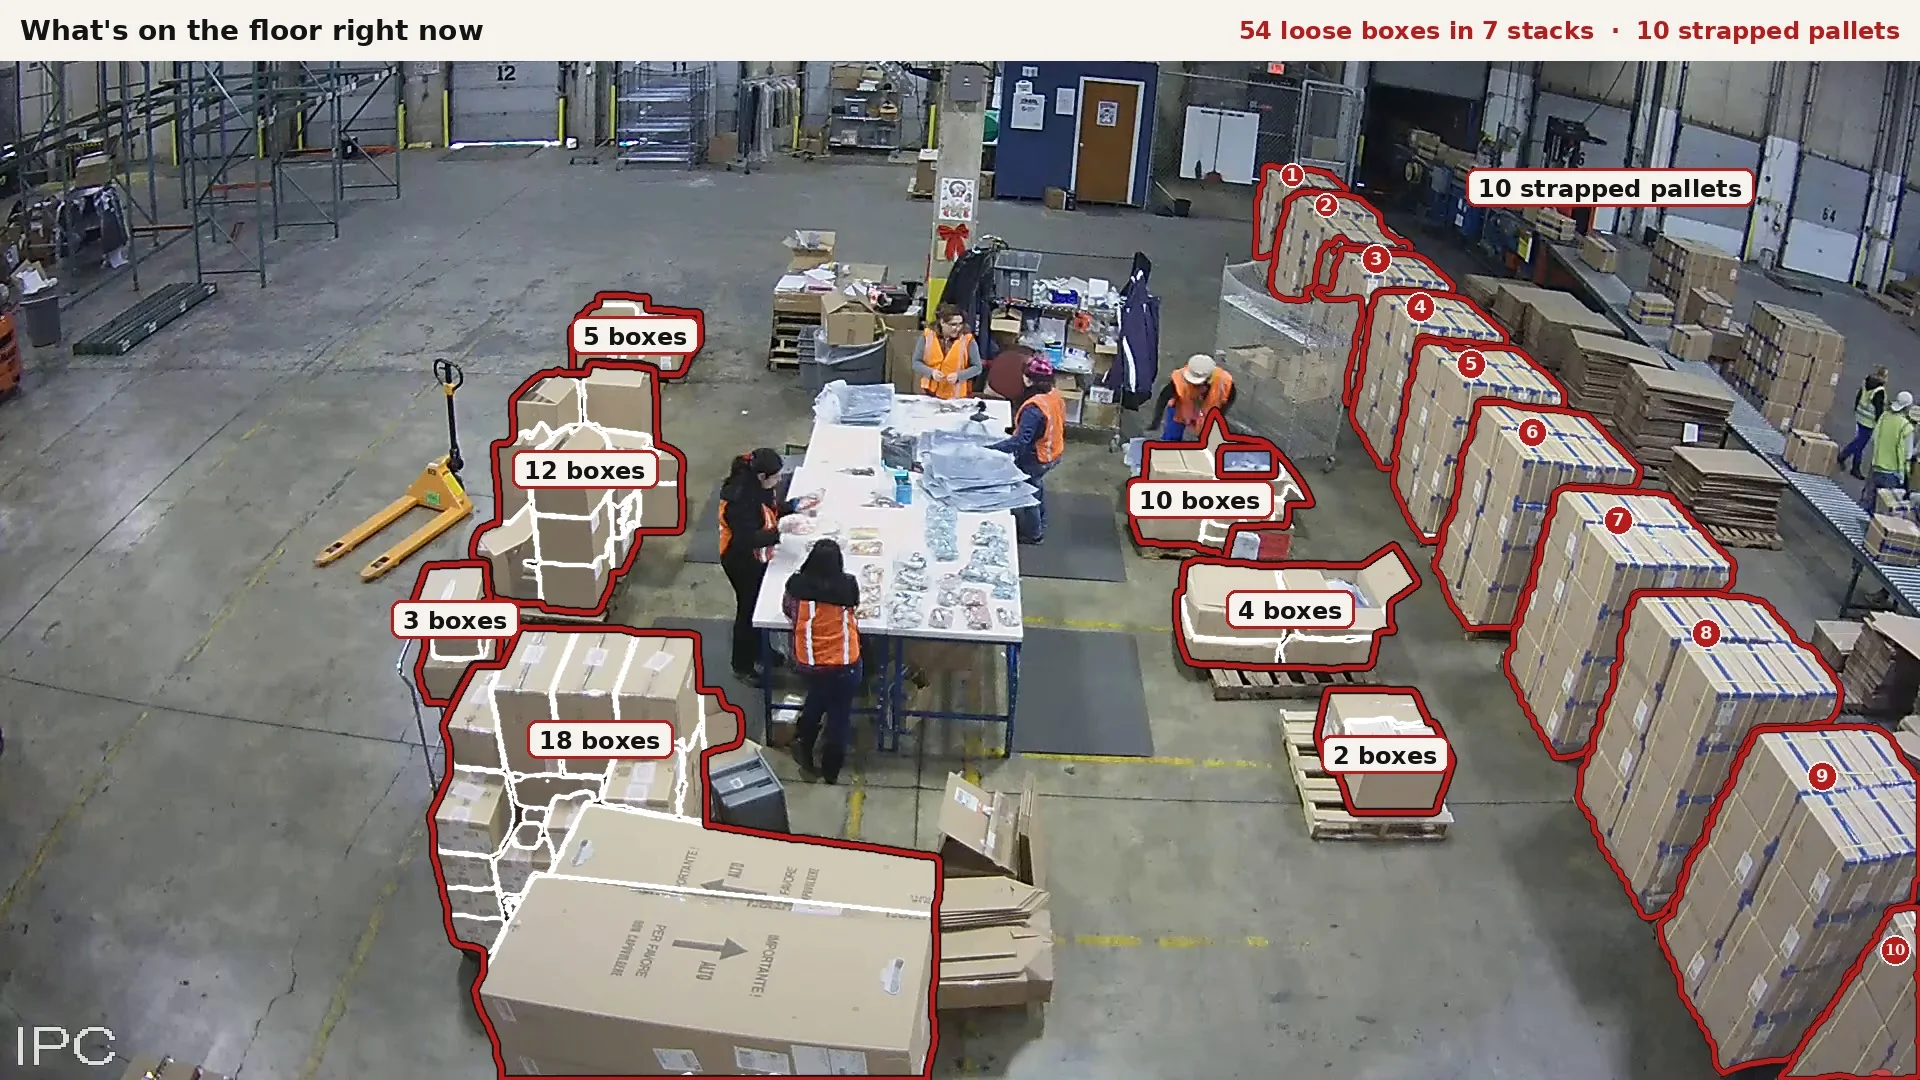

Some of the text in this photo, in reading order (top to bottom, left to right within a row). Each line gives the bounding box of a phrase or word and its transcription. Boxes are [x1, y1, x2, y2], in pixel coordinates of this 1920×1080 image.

[497, 65, 516, 81] 12
[650, 924, 667, 942] PER
[695, 960, 717, 981] ALTO
